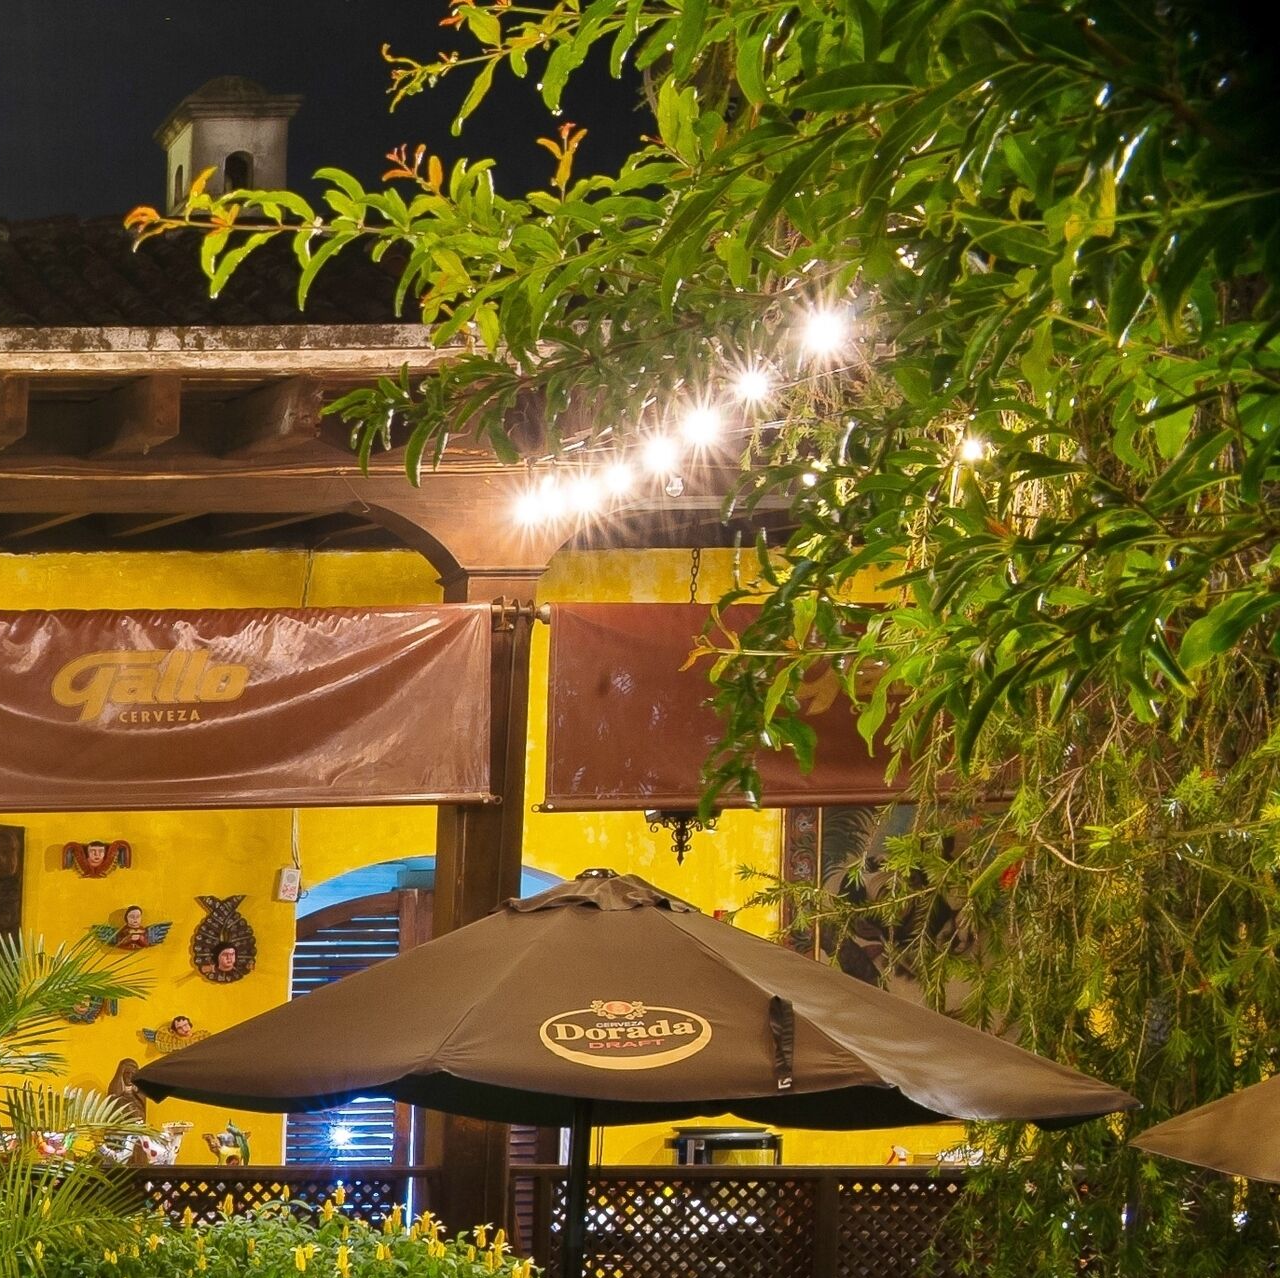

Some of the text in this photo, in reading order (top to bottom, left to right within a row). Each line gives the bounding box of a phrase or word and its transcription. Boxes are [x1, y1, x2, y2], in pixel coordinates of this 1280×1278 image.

[50, 649, 251, 721] Gallo
[119, 709, 201, 722] CERVEZA
[552, 1019, 696, 1041] Dorada
[596, 1020, 645, 1029] CERVEZA
[589, 1038, 665, 1050] DRAFT
